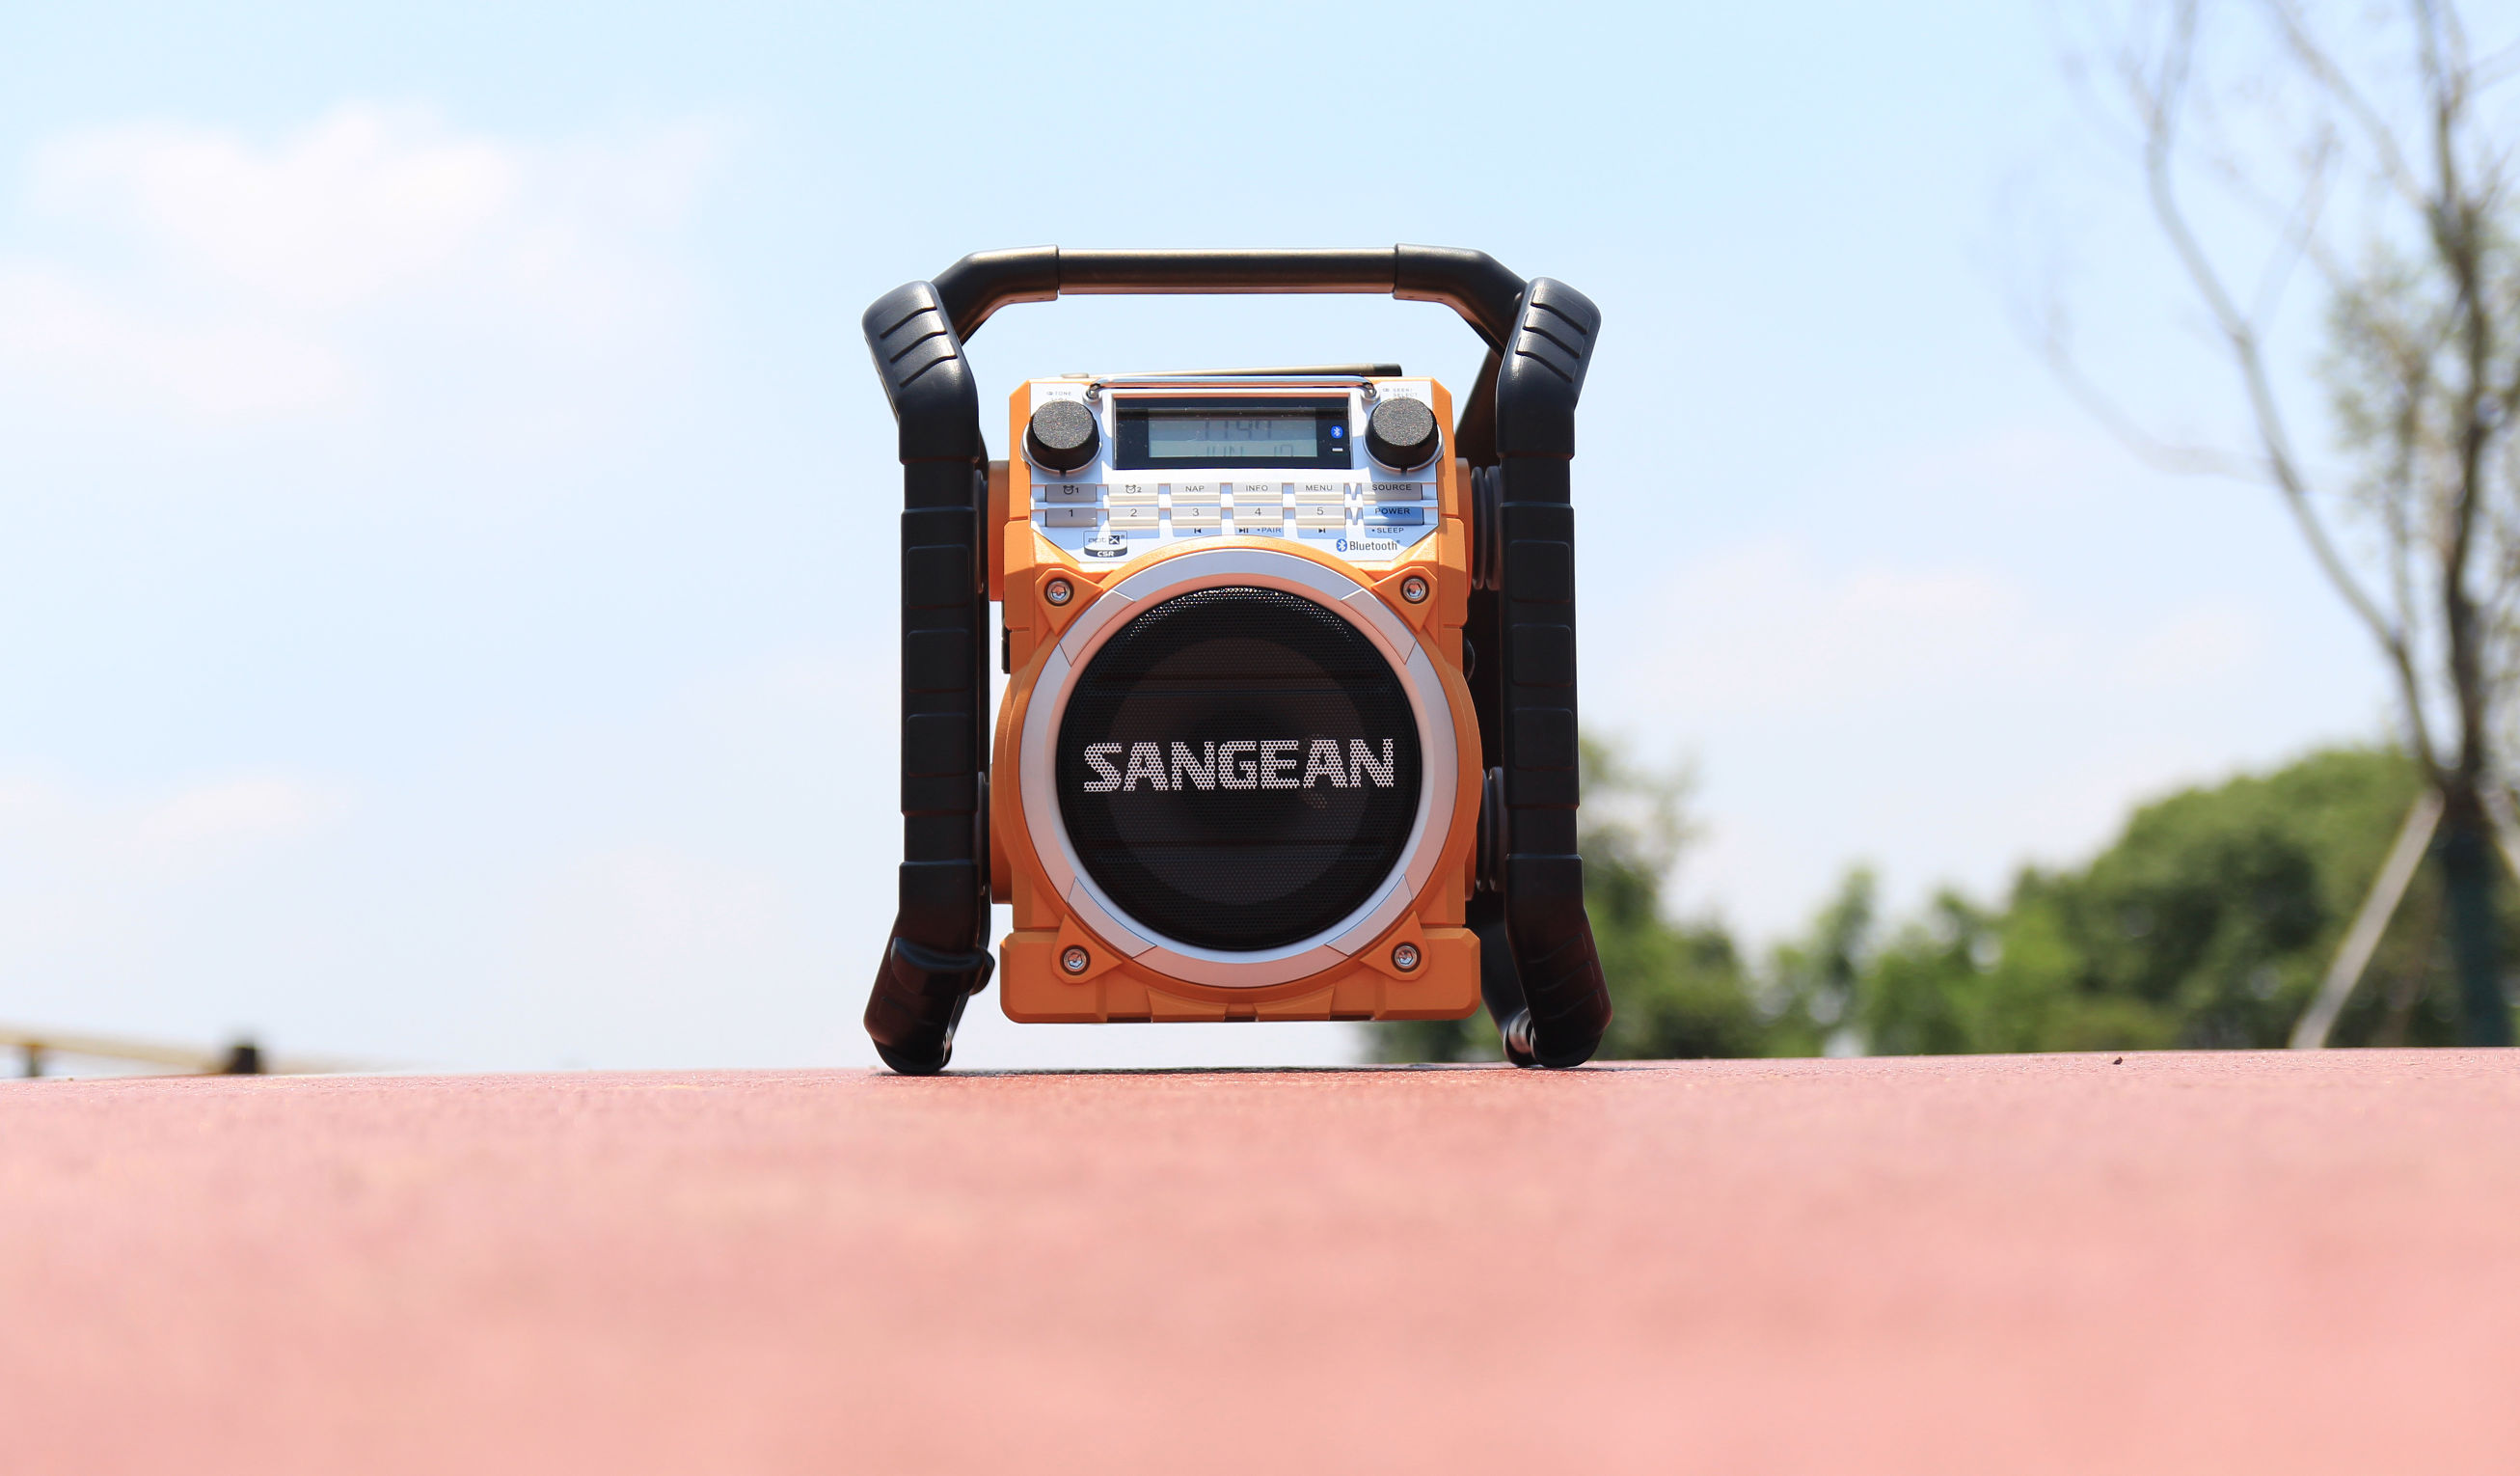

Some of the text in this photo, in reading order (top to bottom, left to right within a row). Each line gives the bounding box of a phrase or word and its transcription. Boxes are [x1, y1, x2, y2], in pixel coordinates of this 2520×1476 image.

[1255, 507, 1261, 516] 4
[1349, 540, 1398, 551] Bluetooth
[1084, 739, 1395, 792] SANGEAN
